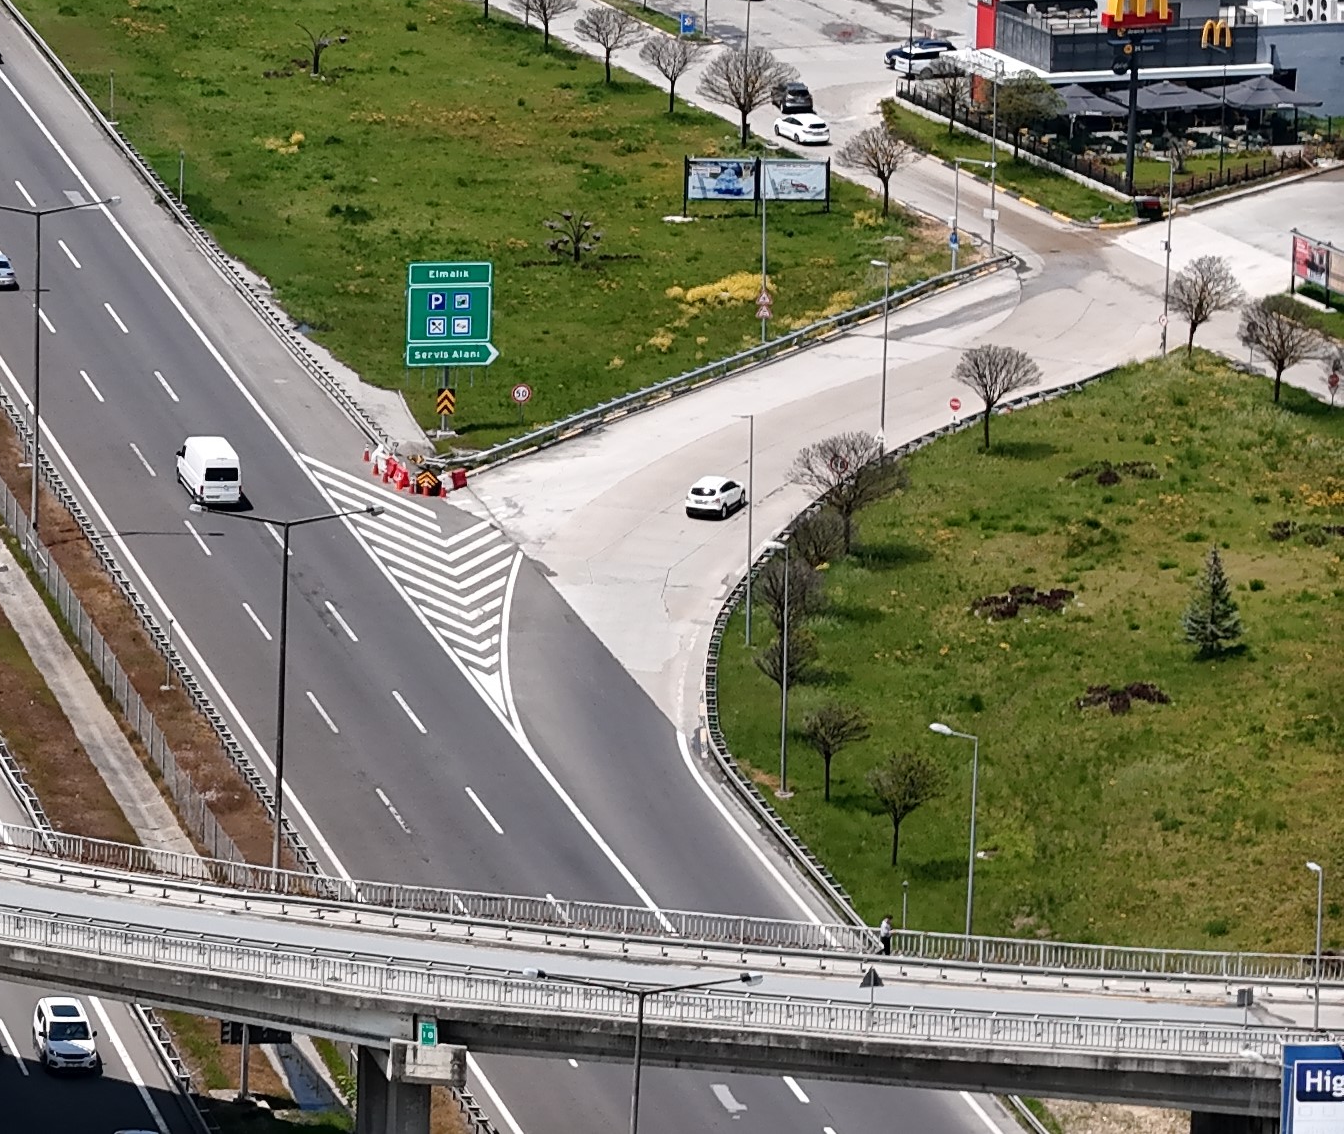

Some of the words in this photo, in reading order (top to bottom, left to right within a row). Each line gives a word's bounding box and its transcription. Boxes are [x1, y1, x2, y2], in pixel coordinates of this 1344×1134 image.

[428, 270, 470, 278] Elmalık
[431, 294, 443, 309] P
[414, 350, 449, 359] Servis
[452, 350, 480, 358] Alanı
[516, 389, 527, 397] 50
[1305, 1069, 1344, 1098] Hig
